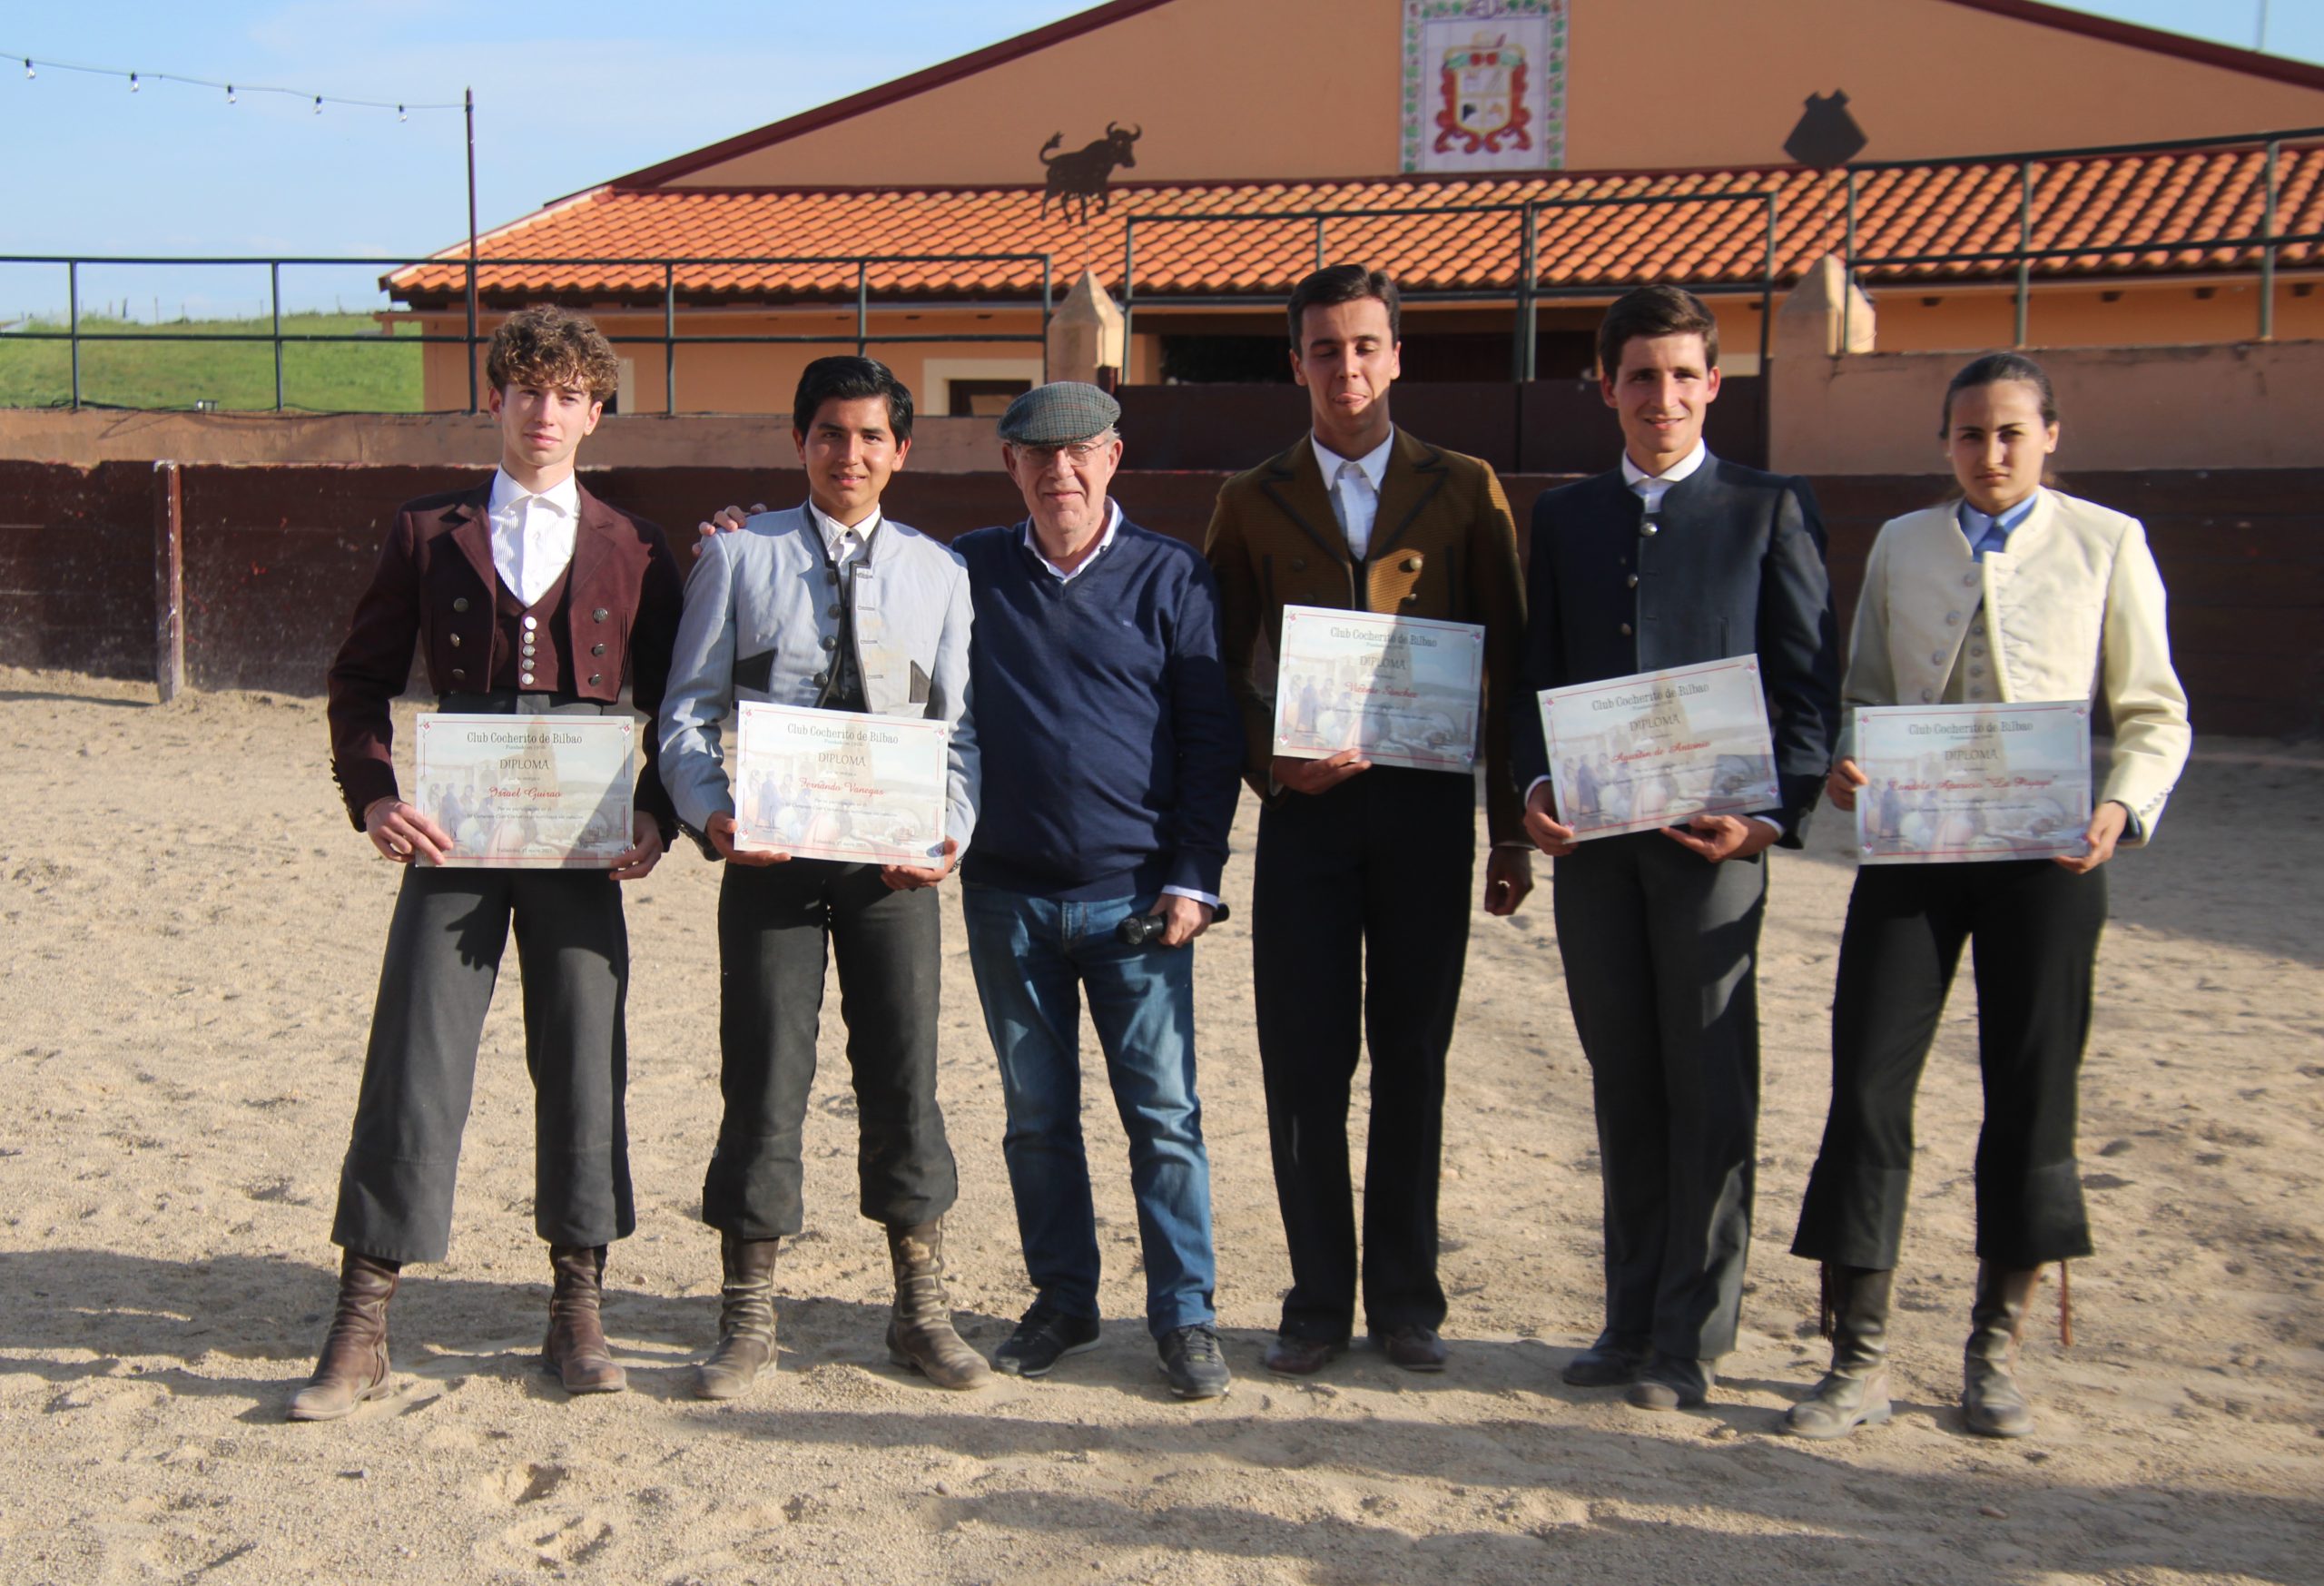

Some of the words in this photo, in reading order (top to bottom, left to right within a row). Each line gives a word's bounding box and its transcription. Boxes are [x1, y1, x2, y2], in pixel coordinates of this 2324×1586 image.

[1330, 626, 1351, 639] Club
[1353, 628, 1396, 644] Cocherito
[1398, 633, 1408, 645] de
[1409, 634, 1438, 647] Bilbao
[1360, 655, 1405, 670] DIPLOMA
[1591, 698, 1614, 711] Club
[1616, 691, 1663, 707] Cocherito
[1665, 688, 1677, 699] de
[1678, 684, 1709, 697] Bilbao
[1630, 714, 1680, 732] DIPLOMA
[1909, 724, 1932, 735] Club
[1934, 723, 1984, 734] Cocherito
[1986, 722, 1997, 734] de
[2000, 721, 2034, 733] Bilbao
[467, 732, 488, 744] Club
[490, 732, 537, 744] Cocherito
[538, 733, 550, 744] de
[553, 733, 583, 744] Bilbao
[787, 723, 808, 735] Club
[810, 725, 854, 741] Cocherito
[856, 730, 868, 742] de
[870, 731, 899, 744] Bilbao
[818, 752, 866, 767] DIPLOMA
[1945, 749, 1999, 762] DIPLOMA
[499, 759, 549, 770] DIPLOMA
[488, 786, 521, 798] Israel
[524, 787, 562, 801] Guirao
[799, 776, 841, 792] Fernando
[844, 782, 885, 797] Vanegas
